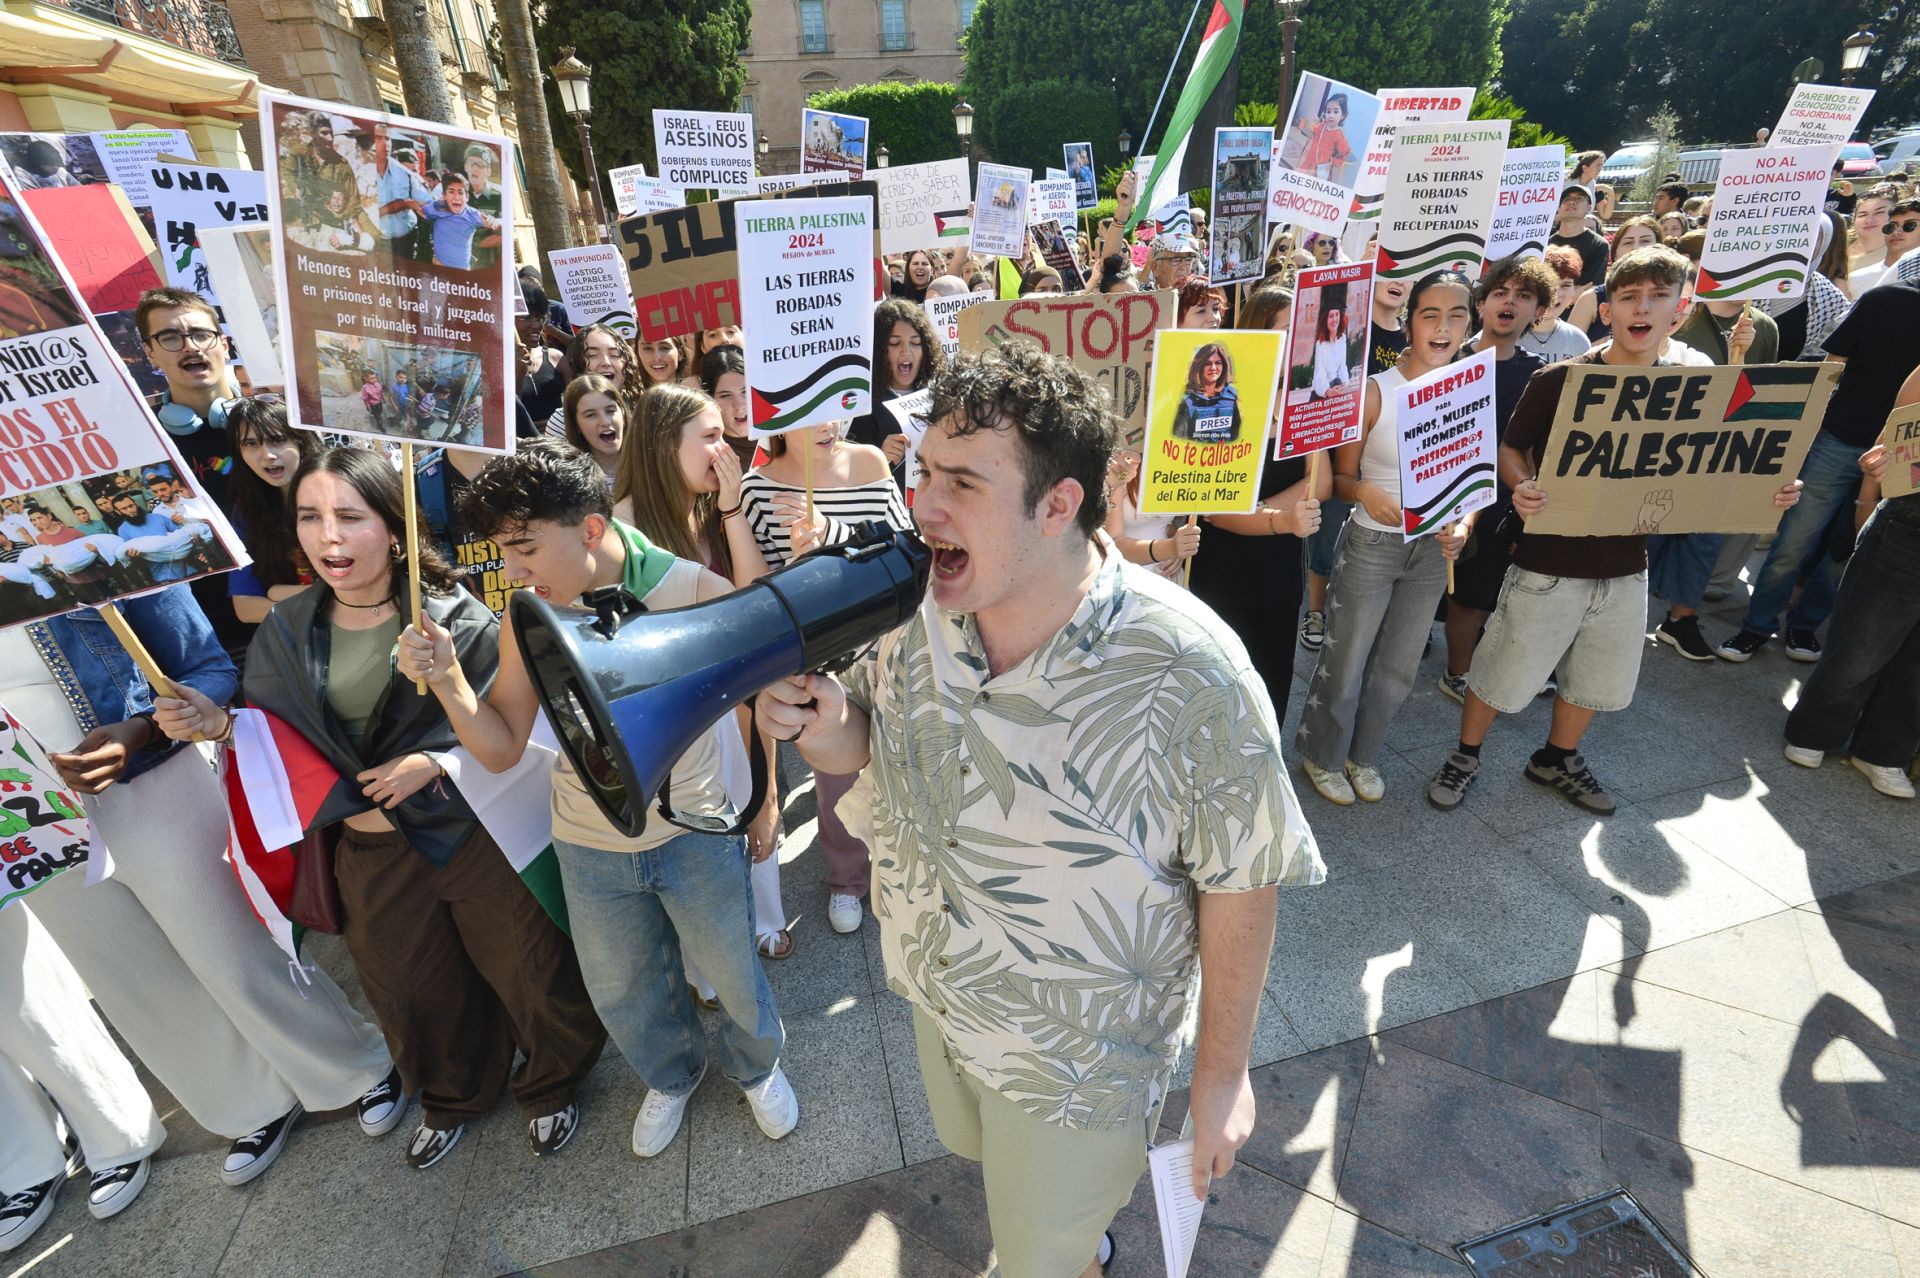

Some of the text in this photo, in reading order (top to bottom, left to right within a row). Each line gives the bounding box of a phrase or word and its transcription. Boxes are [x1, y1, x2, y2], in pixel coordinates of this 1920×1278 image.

[1384, 96, 1462, 111] LIBERTAD
[1794, 100, 1846, 111] GENOCIDIO
[1797, 92, 1861, 104] PAREMOS EL
[1789, 109, 1853, 121] CISJORDANIA
[663, 117, 703, 131] ISRAEL
[716, 120, 745, 132] EEUU
[1800, 121, 1827, 130] NO AL
[665, 130, 748, 148] ASESINOS
[1400, 130, 1504, 145] TIERRA PALESTINA
[1778, 129, 1845, 141] DESPLAZAMIENTO
[1431, 145, 1461, 156] 2024
[661, 156, 752, 168] GOBIERNOS EUROPEOS
[1756, 157, 1797, 168] NO AL
[151, 168, 230, 193] UNA
[670, 166, 748, 184] CÓMPLICES
[889, 168, 920, 181] HORA
[927, 165, 942, 177] DE
[1406, 170, 1483, 183] LAS TIERRAS
[1500, 171, 1560, 186] HOSPITALES
[1722, 170, 1826, 186] COLIONALISMO
[922, 175, 960, 193] SABER
[1039, 183, 1072, 192] ROMPAMOS
[1281, 172, 1345, 200] ASESINADA
[1411, 187, 1468, 199] ROBADAS
[1499, 187, 1556, 206] EN GAZA
[1734, 190, 1801, 205] EJÉRCITO
[896, 190, 961, 213] ESTAMOS A
[1049, 200, 1067, 210] GAZA
[1273, 190, 1340, 222] GENOCIDIO
[1419, 202, 1459, 215] SERÁN
[896, 211, 926, 228] LADO
[1715, 205, 1816, 221] ISRAELÍ FUERA
[744, 212, 866, 234] TIERRA PALESTINA
[1393, 219, 1479, 231] RECUPERADAS
[1493, 214, 1550, 230] QUE PAGUEN
[1490, 228, 1547, 243] ISRAEL y EEUU
[1713, 223, 1809, 238] de PALESTINA
[788, 233, 824, 249] 2024
[1710, 238, 1809, 252] LÍBANO y SIRIA
[569, 253, 613, 264] IMPUNIDAD
[814, 248, 835, 257] MURCIA
[297, 255, 492, 301] Menores palestinos detenidos
[566, 274, 614, 286] CULPABLES
[568, 267, 604, 278] CASTIGO
[765, 267, 855, 291] LAS TIERRAS
[1313, 267, 1361, 283] LAYAN NASIR
[565, 285, 594, 294] LIMPIEZA
[571, 291, 609, 301] GENOCIDIO
[303, 285, 495, 324] en prisiones de Israel y juzgados
[583, 306, 612, 315] GUERRA
[776, 293, 842, 314] ROBADAS
[337, 312, 472, 342] por tribunales militares
[790, 314, 834, 336] SERÁN
[937, 318, 946, 327] el
[1003, 295, 1160, 363] STOP
[763, 335, 861, 363] RECUPERADAS
[15, 360, 100, 397] Israel
[1408, 363, 1485, 409] LIBERTAD
[1572, 373, 1712, 422] FREE
[1294, 401, 1323, 413] ACTIVISTA
[1435, 401, 1451, 412] PARA
[41, 397, 99, 437] EL
[1200, 417, 1230, 429] PRESS
[1404, 394, 1491, 442] NIÑOS, MUJERES
[1422, 417, 1476, 449] HOMBRES
[1162, 439, 1252, 467] No te callarán
[1410, 430, 1483, 471] PRISIONER@S
[1556, 427, 1792, 479] PALESTINE
[1415, 447, 1481, 483] PALESTIN@S
[1152, 470, 1247, 484] Palestina Libre
[1156, 488, 1240, 501] del Río al Mar
